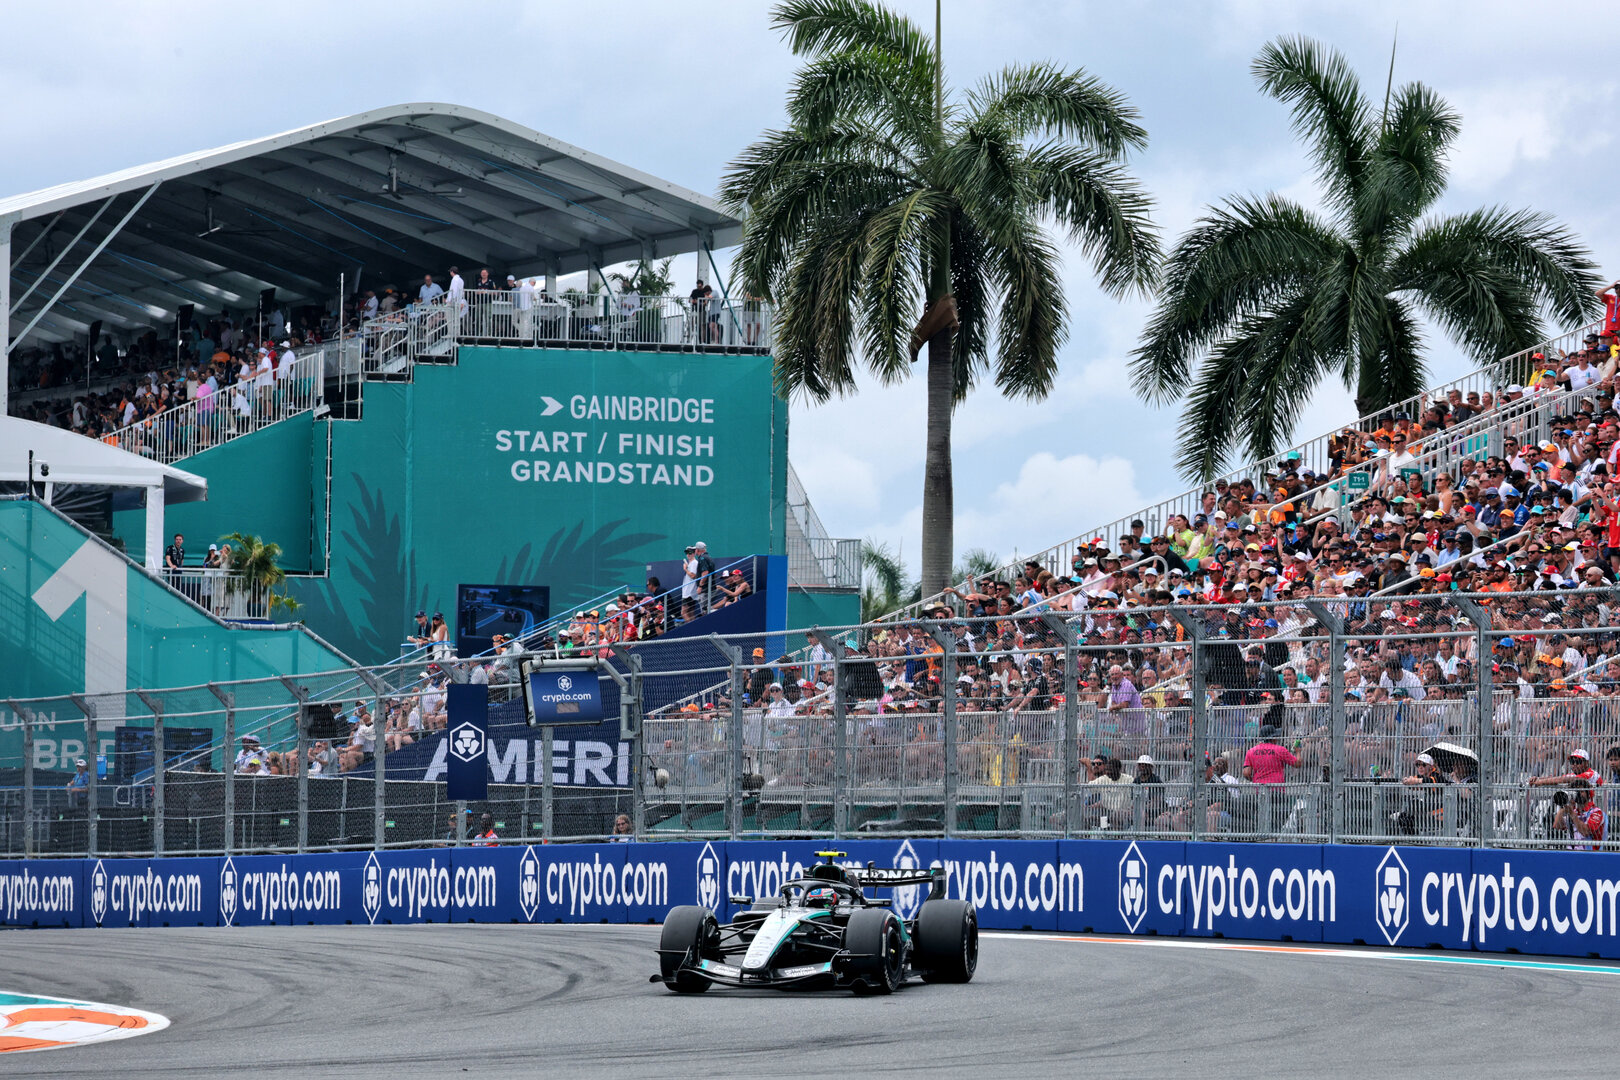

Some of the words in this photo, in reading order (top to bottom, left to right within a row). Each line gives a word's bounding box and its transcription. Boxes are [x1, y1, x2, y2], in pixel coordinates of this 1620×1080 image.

[570, 394, 714, 423] GAINBRIDGE
[495, 430, 588, 453] START
[597, 432, 608, 454] /
[618, 433, 714, 457] FINISH
[511, 459, 714, 486] GRANDSTAND
[541, 693, 592, 703] crypto.com
[111, 867, 201, 920] crypto.com
[242, 863, 341, 920] crypto.com
[387, 858, 496, 918] crypto.com
[546, 852, 668, 916] crypto.com
[1157, 854, 1336, 930] crypto.com
[1421, 862, 1620, 943] crypto.com
